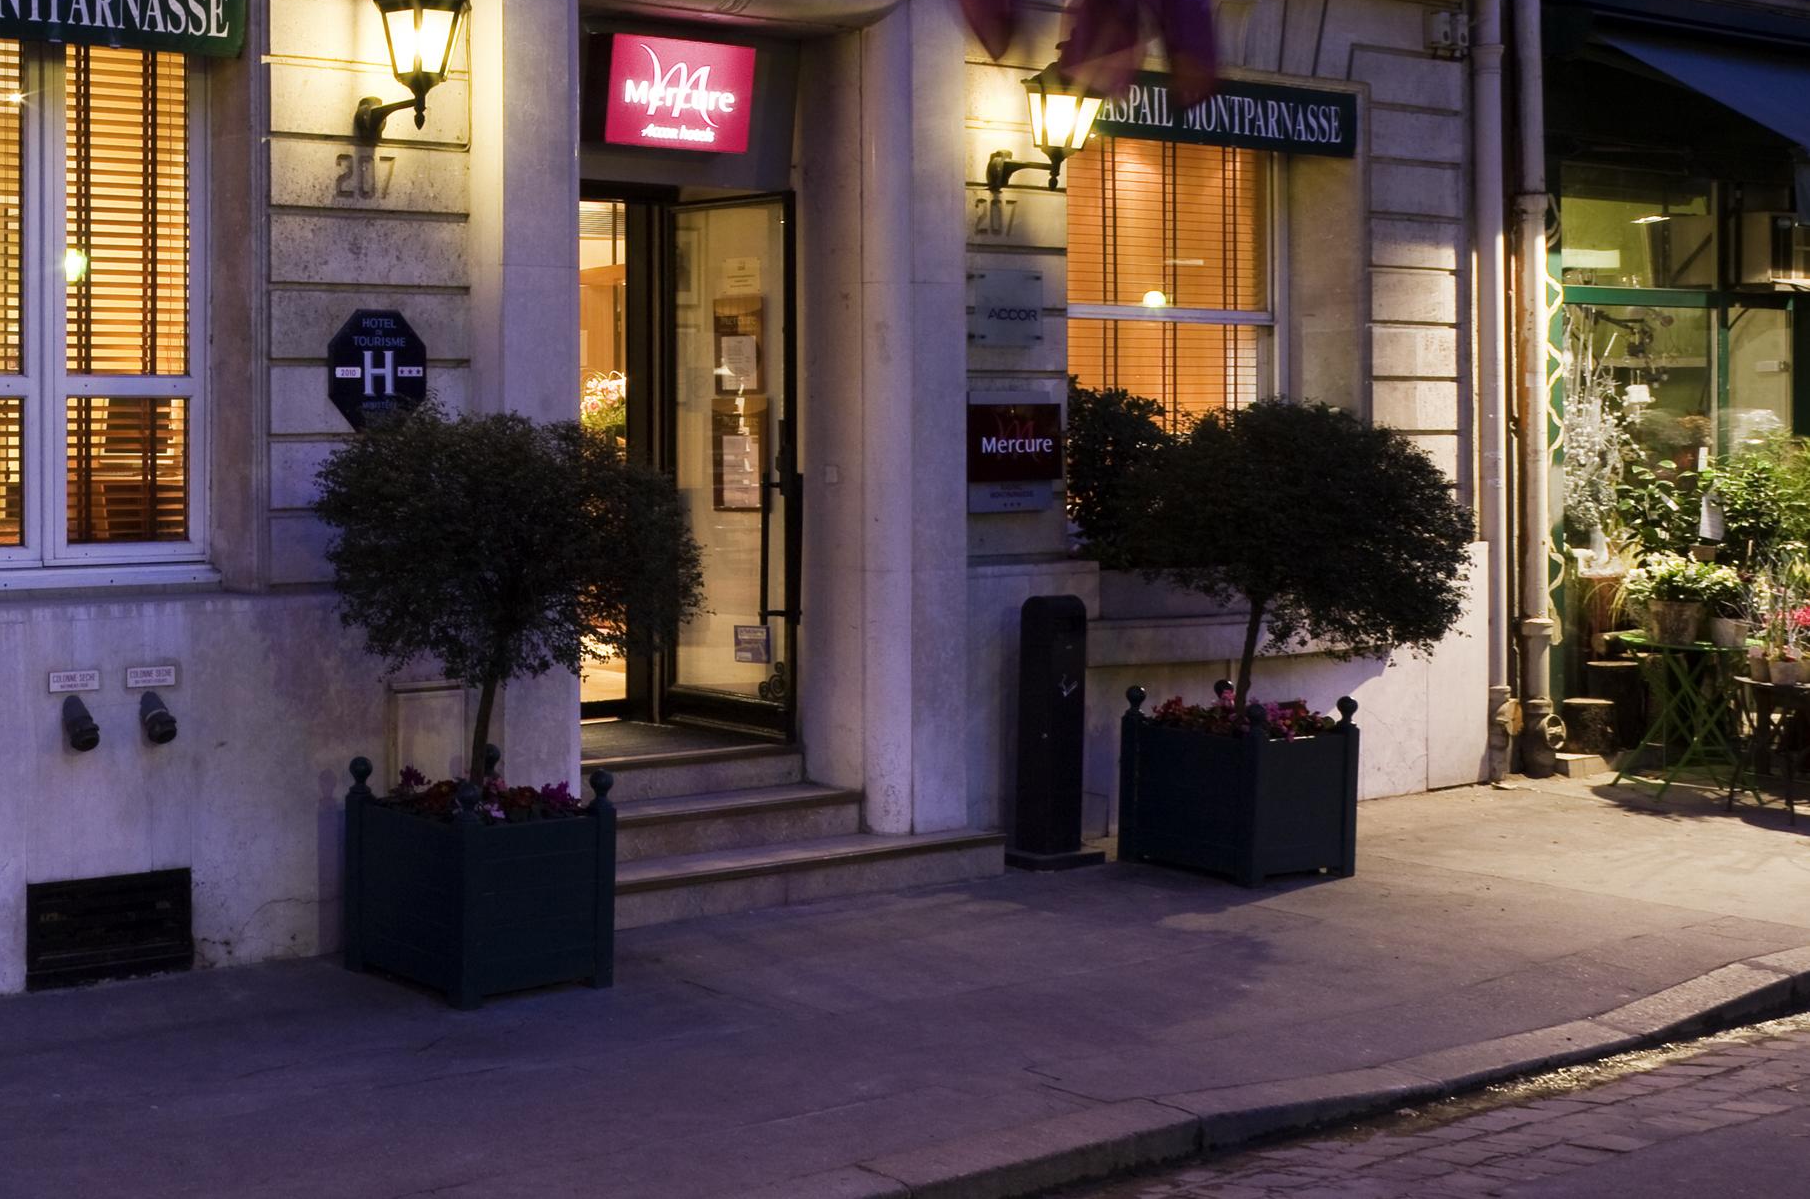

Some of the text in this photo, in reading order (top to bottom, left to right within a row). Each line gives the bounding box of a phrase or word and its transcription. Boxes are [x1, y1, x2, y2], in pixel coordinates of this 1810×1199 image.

[624, 79, 736, 113] Mercure
[1096, 85, 1173, 126] ASPAIL
[336, 154, 396, 200] 207
[975, 199, 1018, 236] 207
[362, 317, 397, 329] HOTEL
[988, 307, 1038, 321] ACCOR
[352, 336, 406, 347] TOURISME
[340, 350, 396, 397] 2010 H
[981, 437, 1054, 453] Mercure
